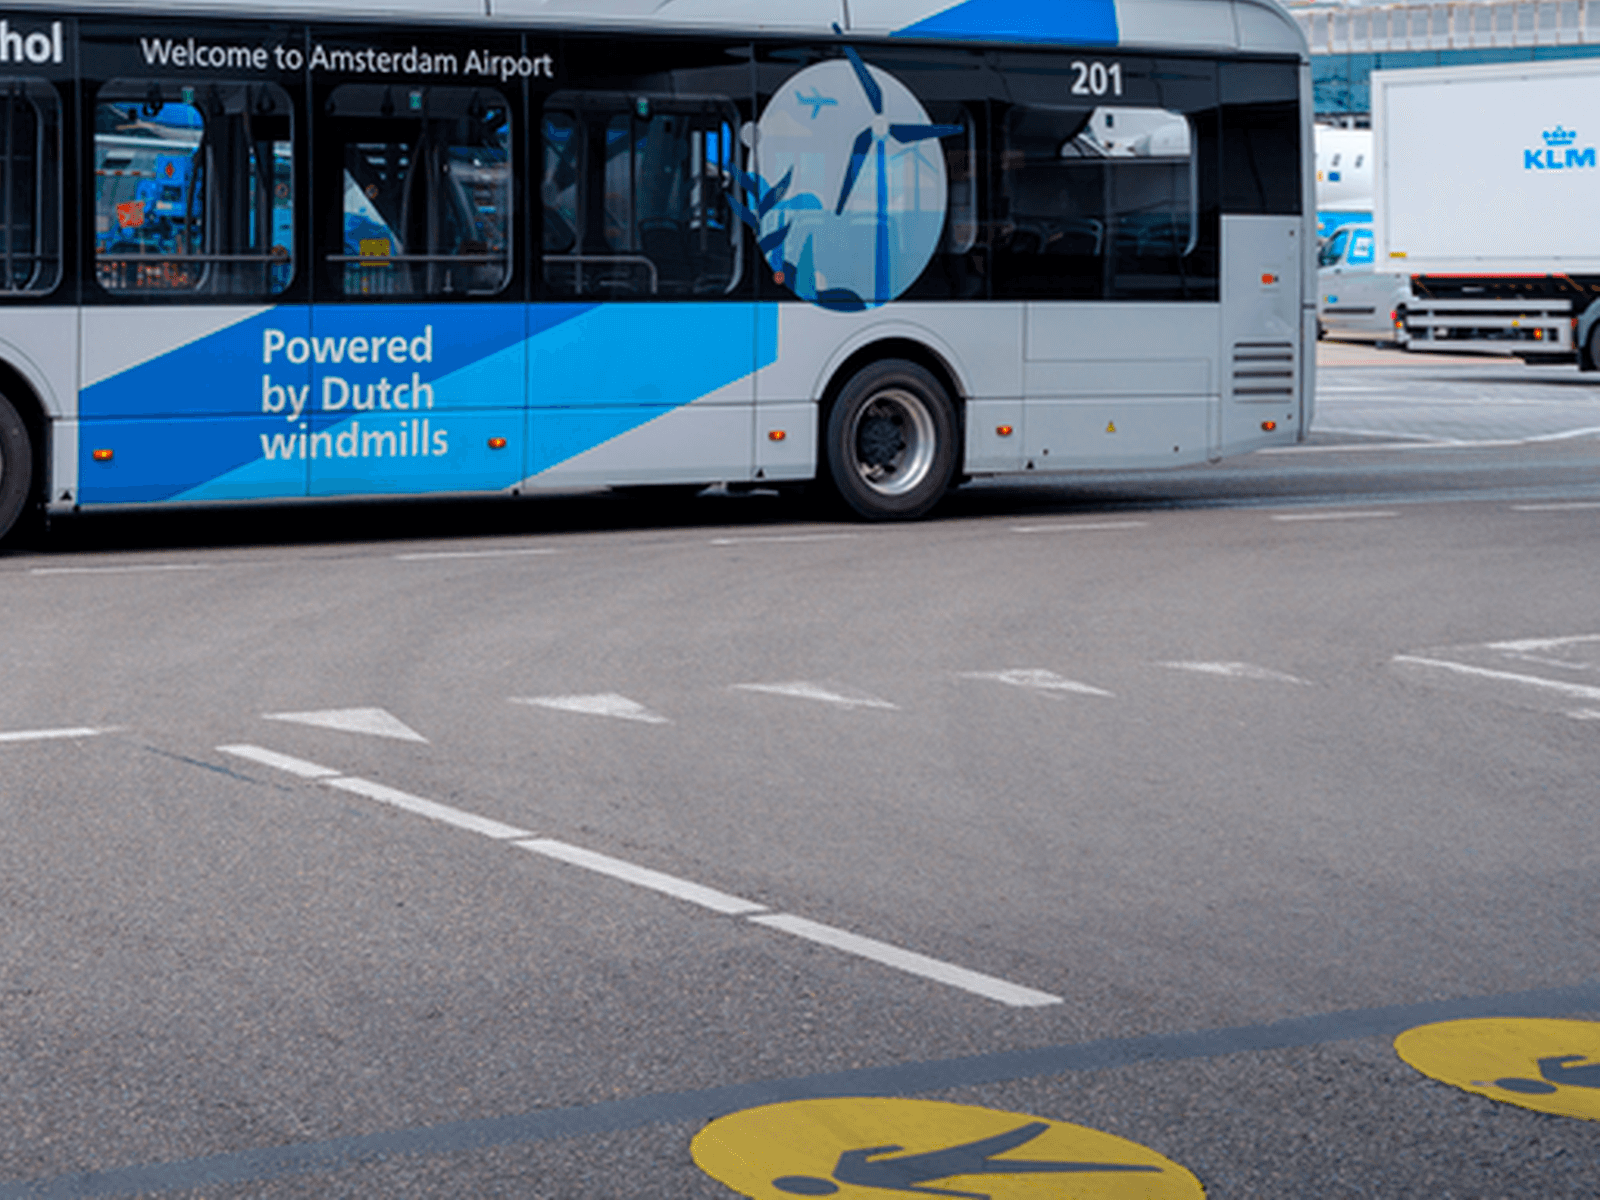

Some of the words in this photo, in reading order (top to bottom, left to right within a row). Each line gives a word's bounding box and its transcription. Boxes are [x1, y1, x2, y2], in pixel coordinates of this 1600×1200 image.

[140, 37, 268, 67] Welcome
[274, 44, 303, 70] to
[309, 44, 457, 74] Amsterdam
[463, 49, 553, 82] Airport
[1070, 61, 1121, 96] 201
[1523, 147, 1596, 169] KLM
[262, 324, 433, 364] Powered
[261, 373, 310, 422] by
[321, 371, 434, 411] Dutch
[259, 417, 448, 460] windmills
